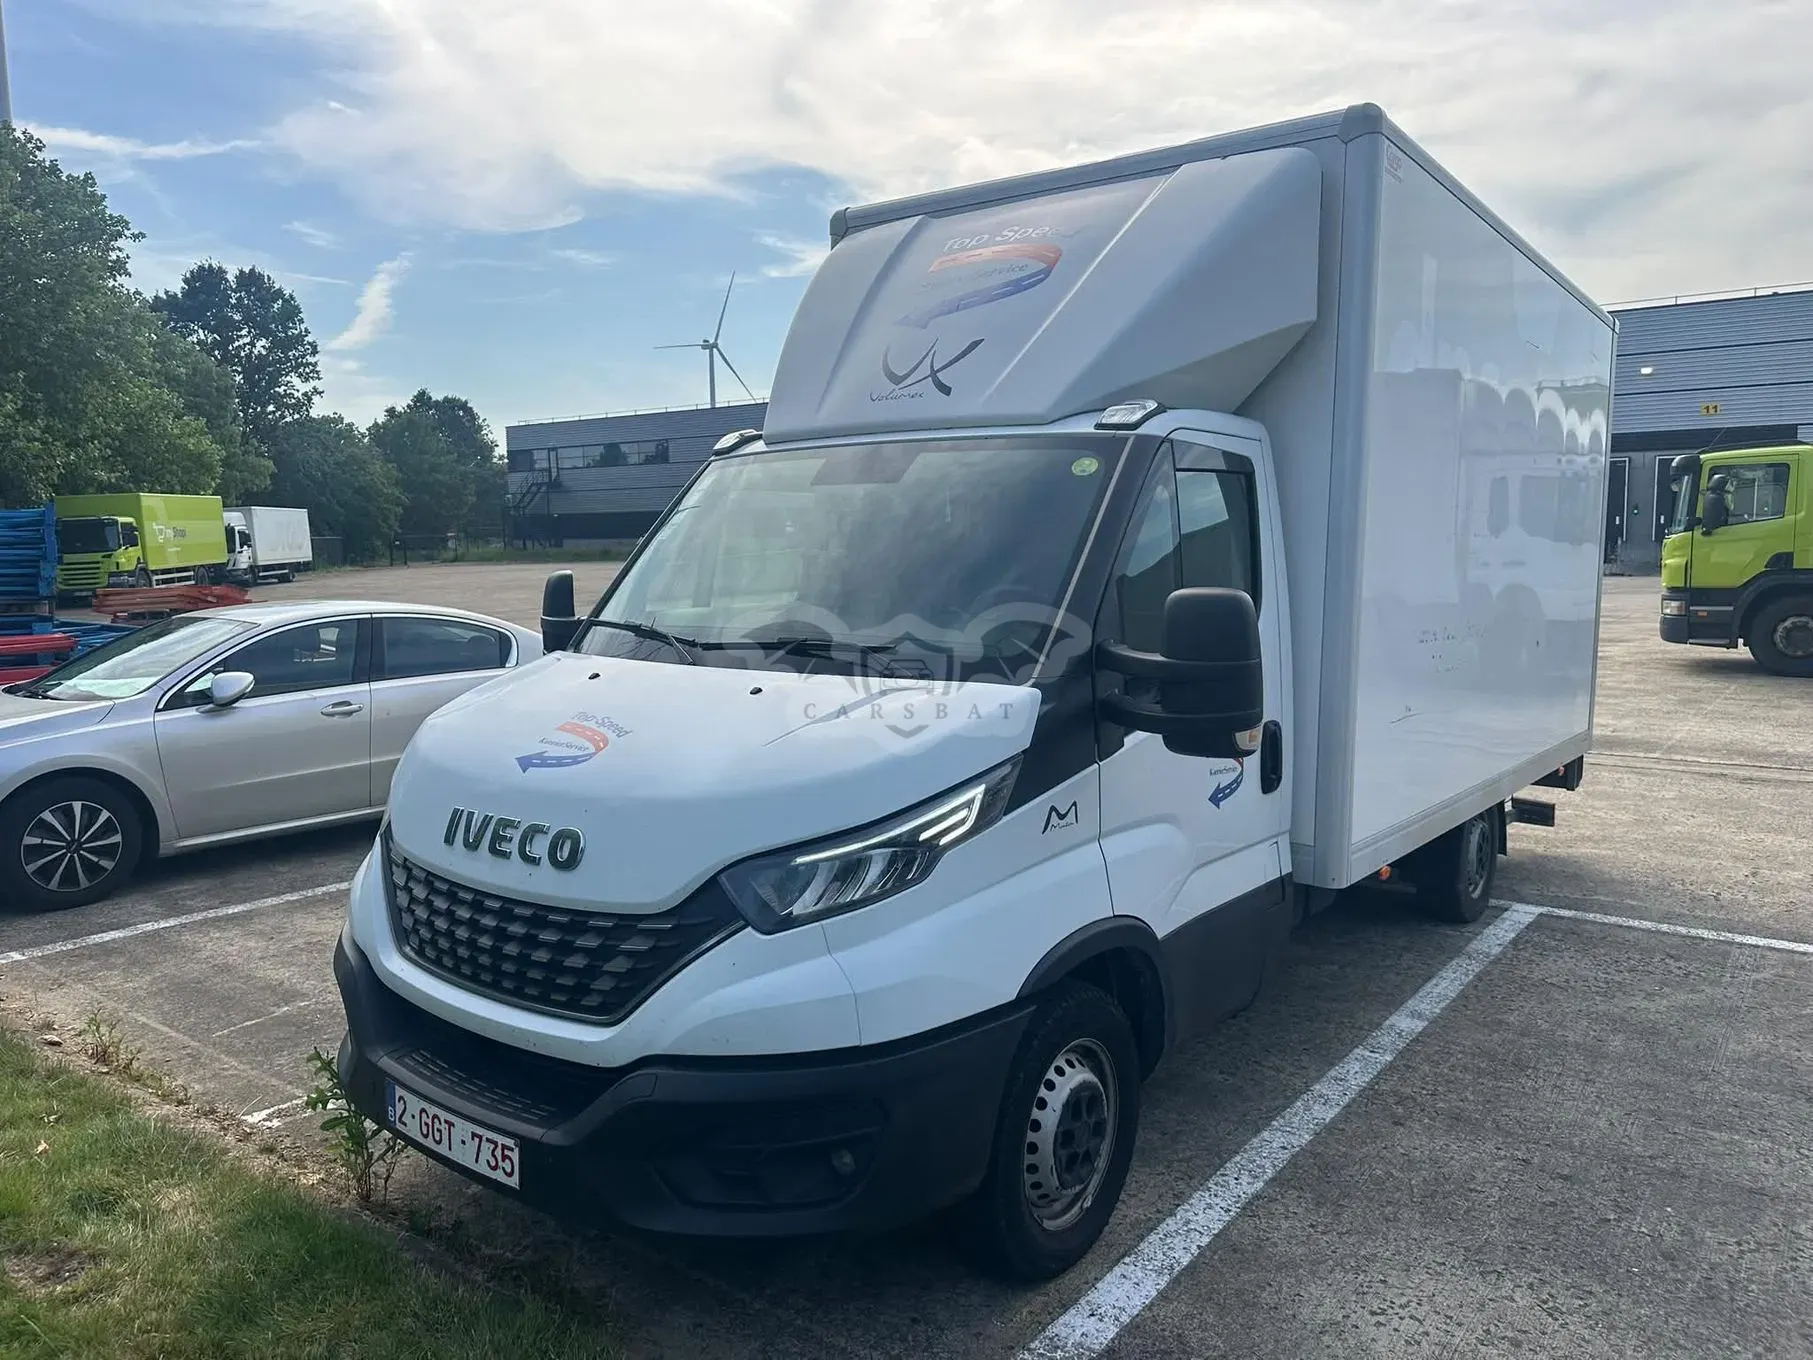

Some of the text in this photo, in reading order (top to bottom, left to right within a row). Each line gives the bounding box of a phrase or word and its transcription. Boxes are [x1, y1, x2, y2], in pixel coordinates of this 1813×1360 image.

[943, 234, 989, 252] Top
[1703, 404, 1718, 414] 11
[443, 806, 587, 872] IVECO
[397, 1095, 515, 1179] 2-GGT-735
